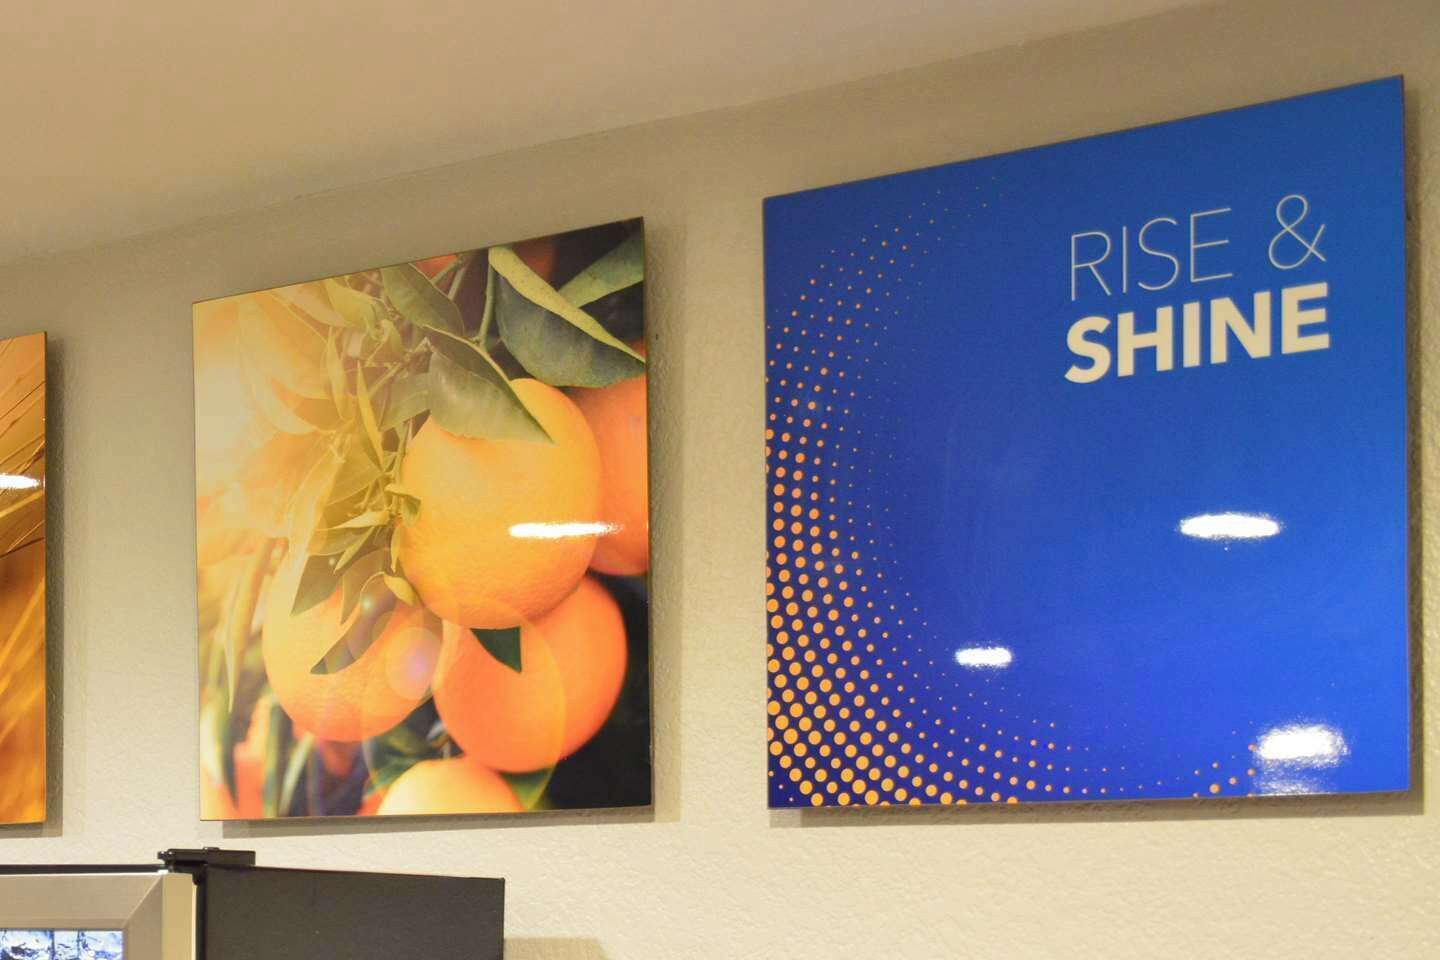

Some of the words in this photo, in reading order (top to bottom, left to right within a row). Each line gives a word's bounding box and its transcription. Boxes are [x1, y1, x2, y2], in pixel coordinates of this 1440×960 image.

[1070, 207, 1234, 302] RISE
[1267, 194, 1327, 270] &
[1063, 281, 1331, 384] SHINE
